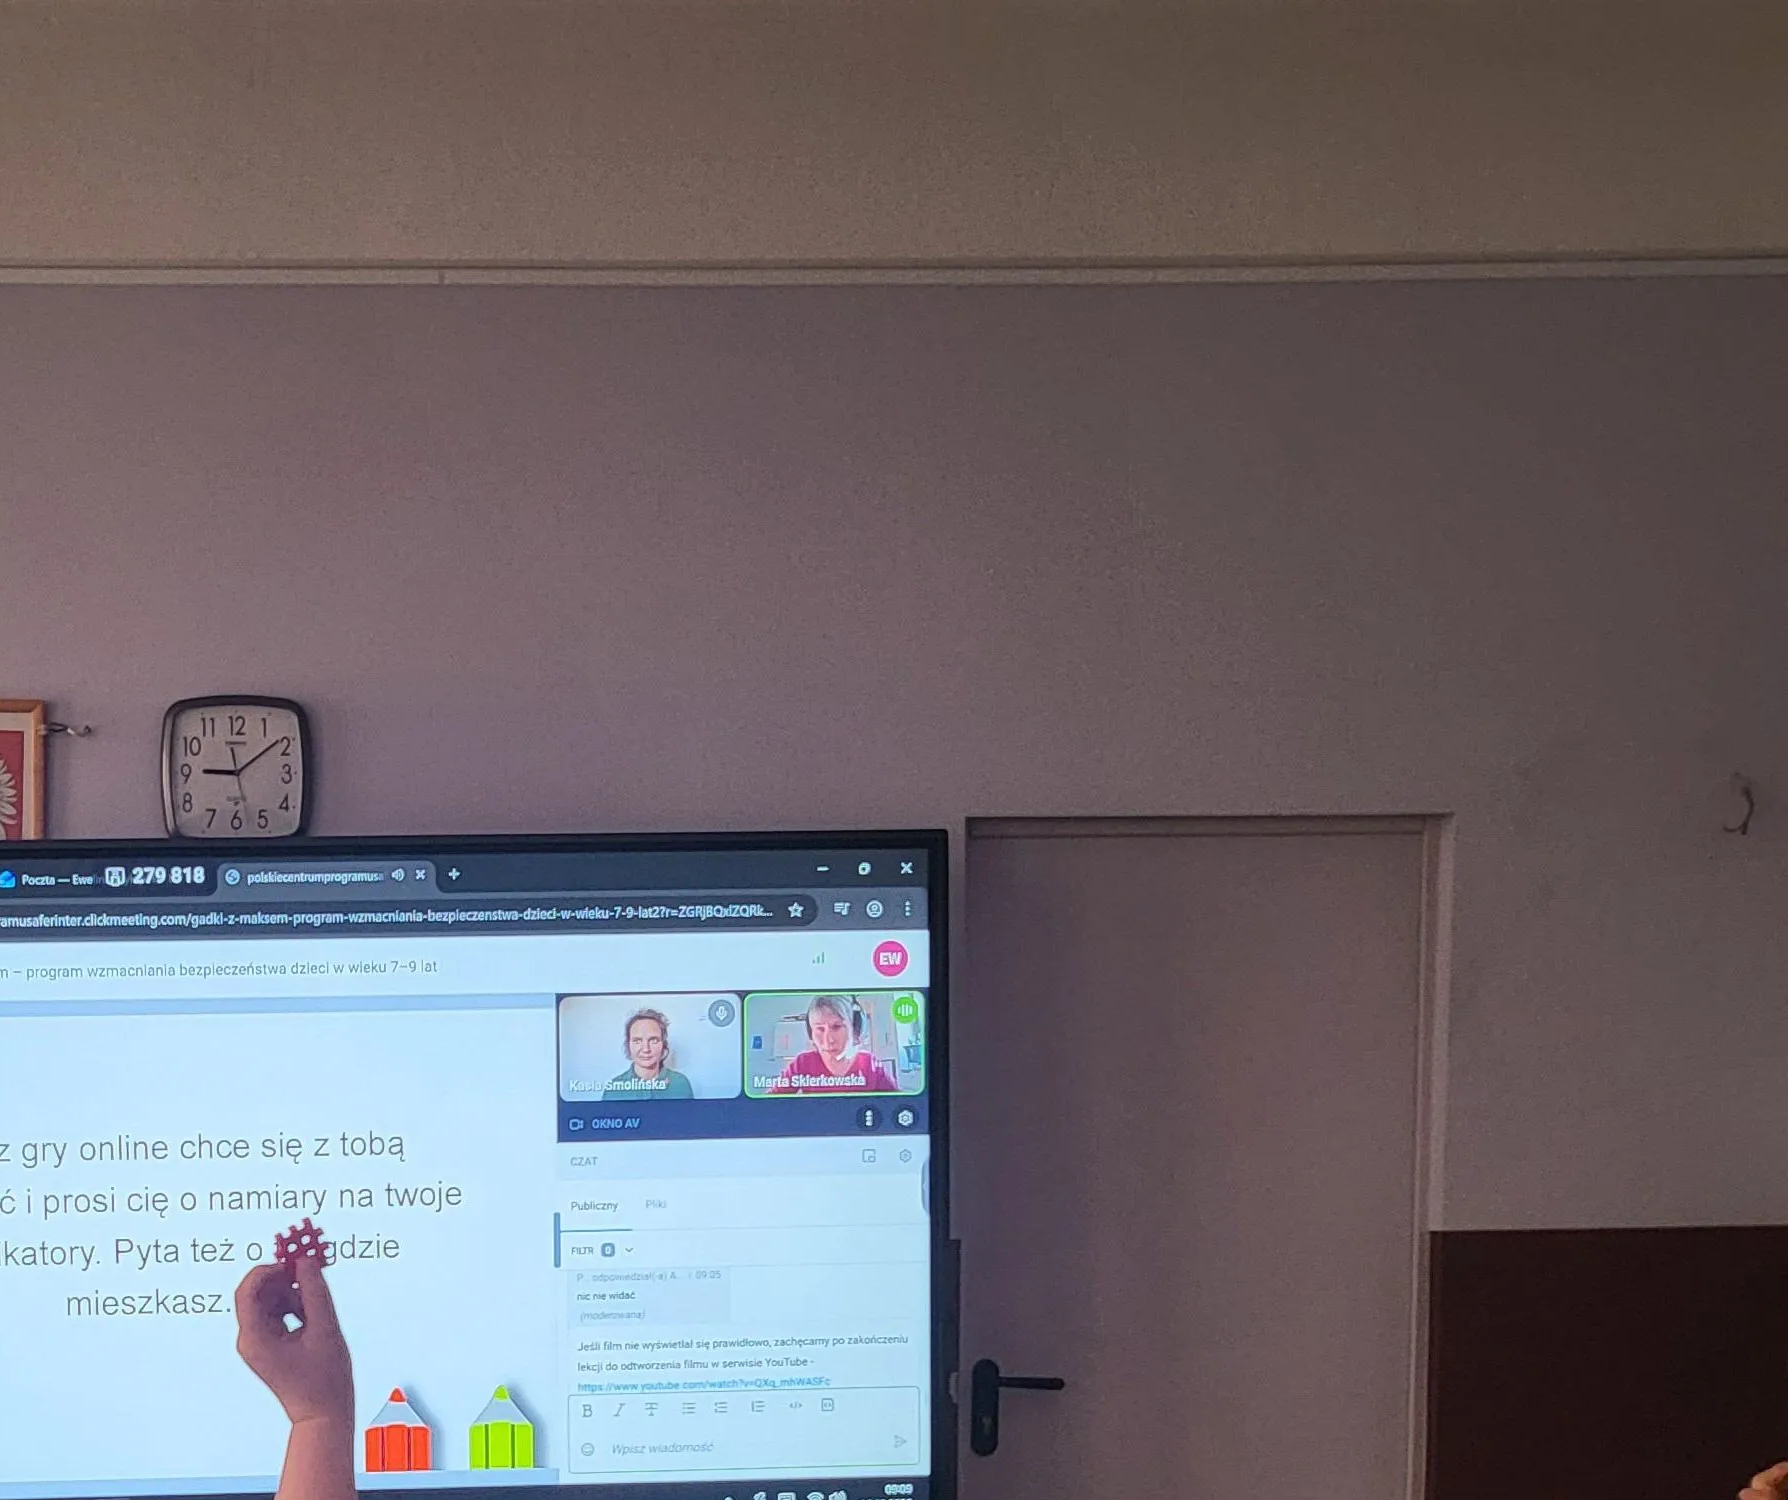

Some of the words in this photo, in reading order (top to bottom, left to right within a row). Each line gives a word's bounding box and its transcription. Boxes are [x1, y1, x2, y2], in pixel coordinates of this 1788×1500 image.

[201, 717, 215, 737] 11
[228, 716, 245, 736] 12
[262, 718, 266, 738] 1
[183, 737, 201, 756] 10
[280, 737, 291, 756] 2
[181, 764, 192, 783] 9
[281, 764, 292, 784] 3
[183, 793, 192, 812] 8
[279, 793, 289, 813] 4
[205, 809, 216, 828] 7
[231, 810, 242, 829] 6
[257, 809, 268, 829] 5
[22, 874, 54, 886] Poczta
[132, 867, 166, 884] 279
[170, 866, 205, 883] 818
[878, 952, 902, 966] EW
[26, 967, 83, 981] program
[88, 964, 175, 977] wzmacniania
[180, 962, 286, 978] bezpieczeństwa
[291, 962, 329, 974] dzieci
[333, 964, 344, 973] w
[349, 961, 386, 973] wieku
[421, 960, 437, 972] lat
[605, 1080, 666, 1090] Smolińska
[754, 1076, 788, 1088] Marta
[791, 1074, 864, 1086] Skierkowska
[592, 1120, 622, 1128] OKNO
[625, 1119, 640, 1128] AV
[21, 1143, 66, 1169] gry
[79, 1136, 168, 1162] online
[180, 1134, 250, 1161] chce
[261, 1133, 303, 1165] się
[313, 1140, 330, 1157] z
[340, 1131, 405, 1162] tobą
[570, 1157, 598, 1167] CZAT
[26, 1191, 31, 1214] i
[43, 1187, 116, 1220] prosi
[128, 1188, 169, 1220] cię
[180, 1193, 197, 1212] o
[209, 1184, 326, 1216] namiary
[339, 1188, 374, 1208] na
[386, 1182, 463, 1212] twoje
[571, 1201, 618, 1212] Publiczny
[645, 1200, 667, 1209] Pliki
[115, 1240, 179, 1269] Pyta
[190, 1239, 236, 1263] też
[245, 1243, 262, 1262] o
[322, 1236, 401, 1266] gdzie
[571, 1246, 594, 1256] FILTR
[66, 1288, 233, 1318] mieszkasz.
[577, 1292, 591, 1301] nic
[593, 1292, 607, 1301] nie
[609, 1291, 635, 1300] widać
[578, 1341, 601, 1352] Jeśli
[603, 1341, 623, 1351] film
[625, 1341, 639, 1350] nie
[642, 1339, 694, 1351] wyświetlał
[697, 1339, 710, 1350] się
[712, 1337, 771, 1350] prawidłowo,
[774, 1336, 829, 1348] zachęcamy
[833, 1338, 845, 1347] po
[847, 1334, 908, 1345] zakończeniu
[577, 1361, 603, 1373] lekcji
[605, 1362, 618, 1371] do
[621, 1359, 681, 1371] odtworzenia
[684, 1359, 709, 1369] filmu
[722, 1358, 762, 1368] serwisie
[765, 1357, 808, 1367] YouTube
[611, 1442, 644, 1455] Wpisz
[649, 1441, 714, 1453] wiadomość
